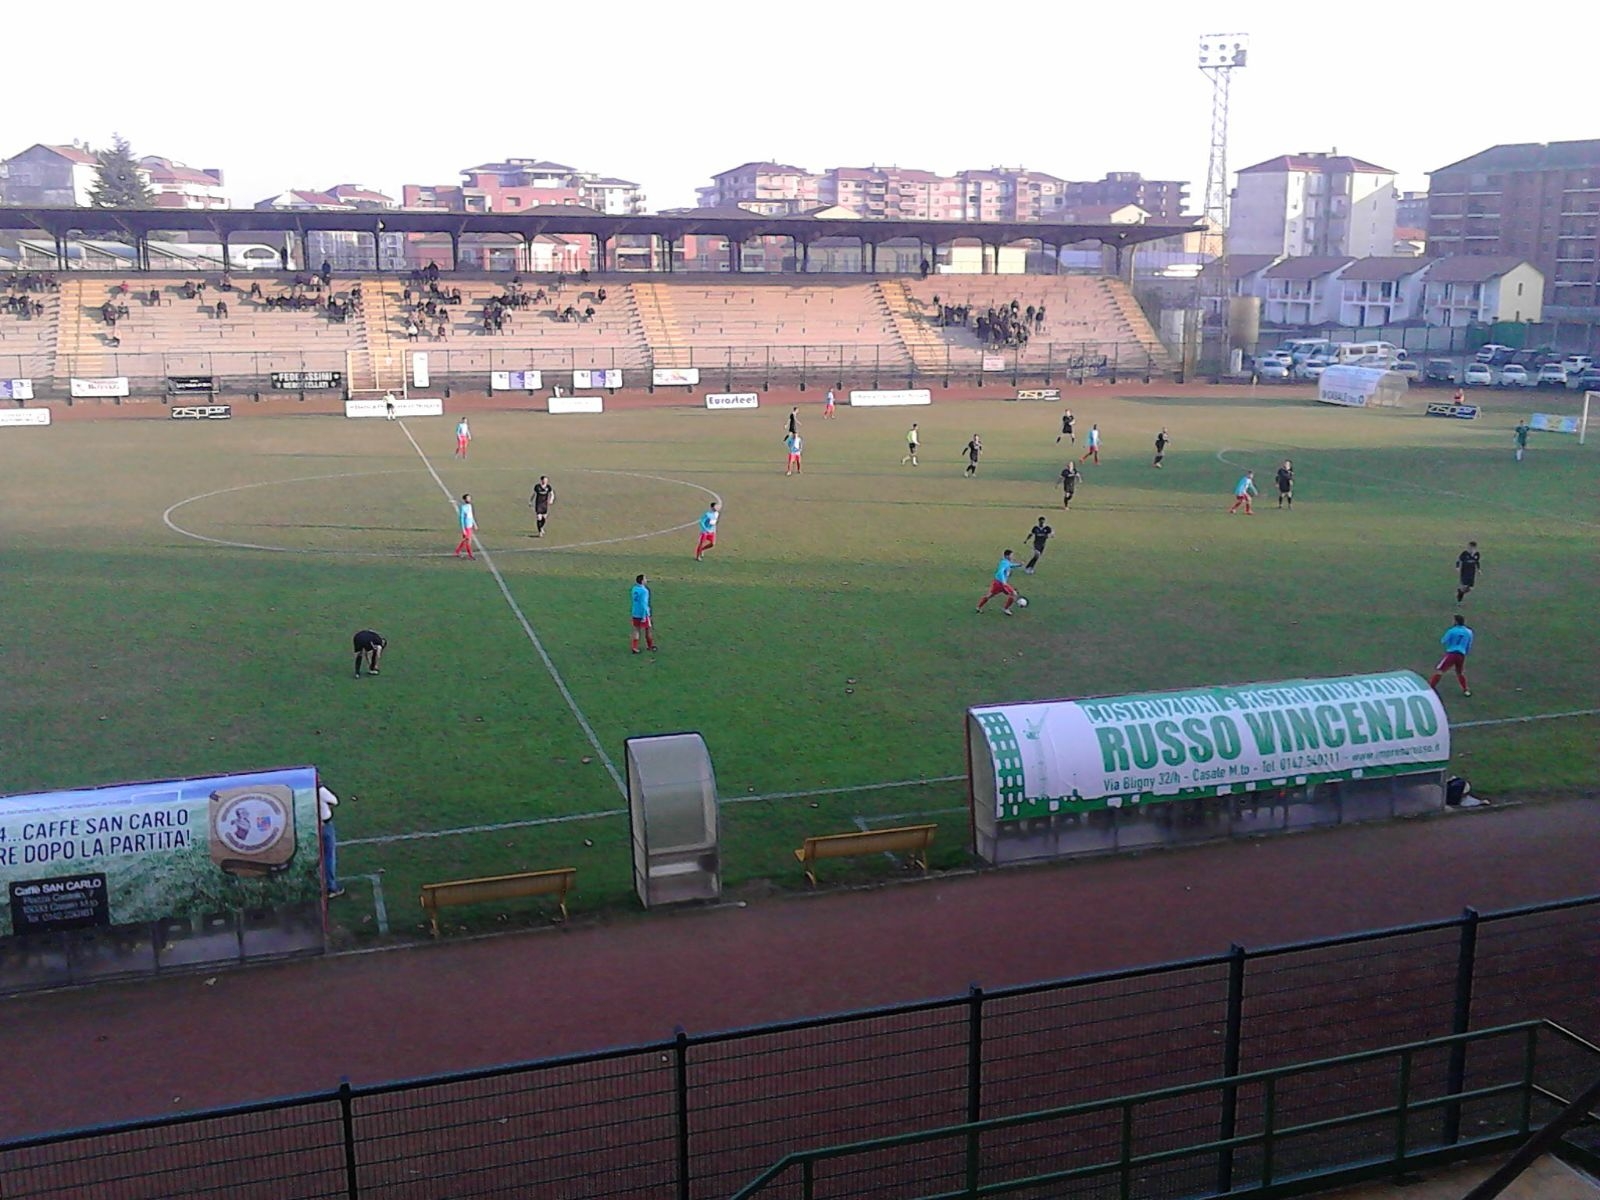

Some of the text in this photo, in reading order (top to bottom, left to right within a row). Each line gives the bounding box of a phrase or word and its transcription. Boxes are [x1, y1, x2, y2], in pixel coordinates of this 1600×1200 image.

[1086, 695, 1220, 723] COSTRUZIONI
[1239, 676, 1420, 709] RISTRUTTURAZIONI
[1095, 695, 1438, 773] RUSSO VINCENZO
[1103, 778, 1120, 791] Via
[1192, 767, 1226, 781] Casale
[86, 816, 123, 835] SAN
[129, 809, 188, 830] CARLO
[24, 840, 75, 864] DOPO
[81, 838, 104, 858] LA
[110, 829, 191, 854] PARTITA!
[42, 882, 64, 893] SAN
[66, 878, 102, 891] CARLO
